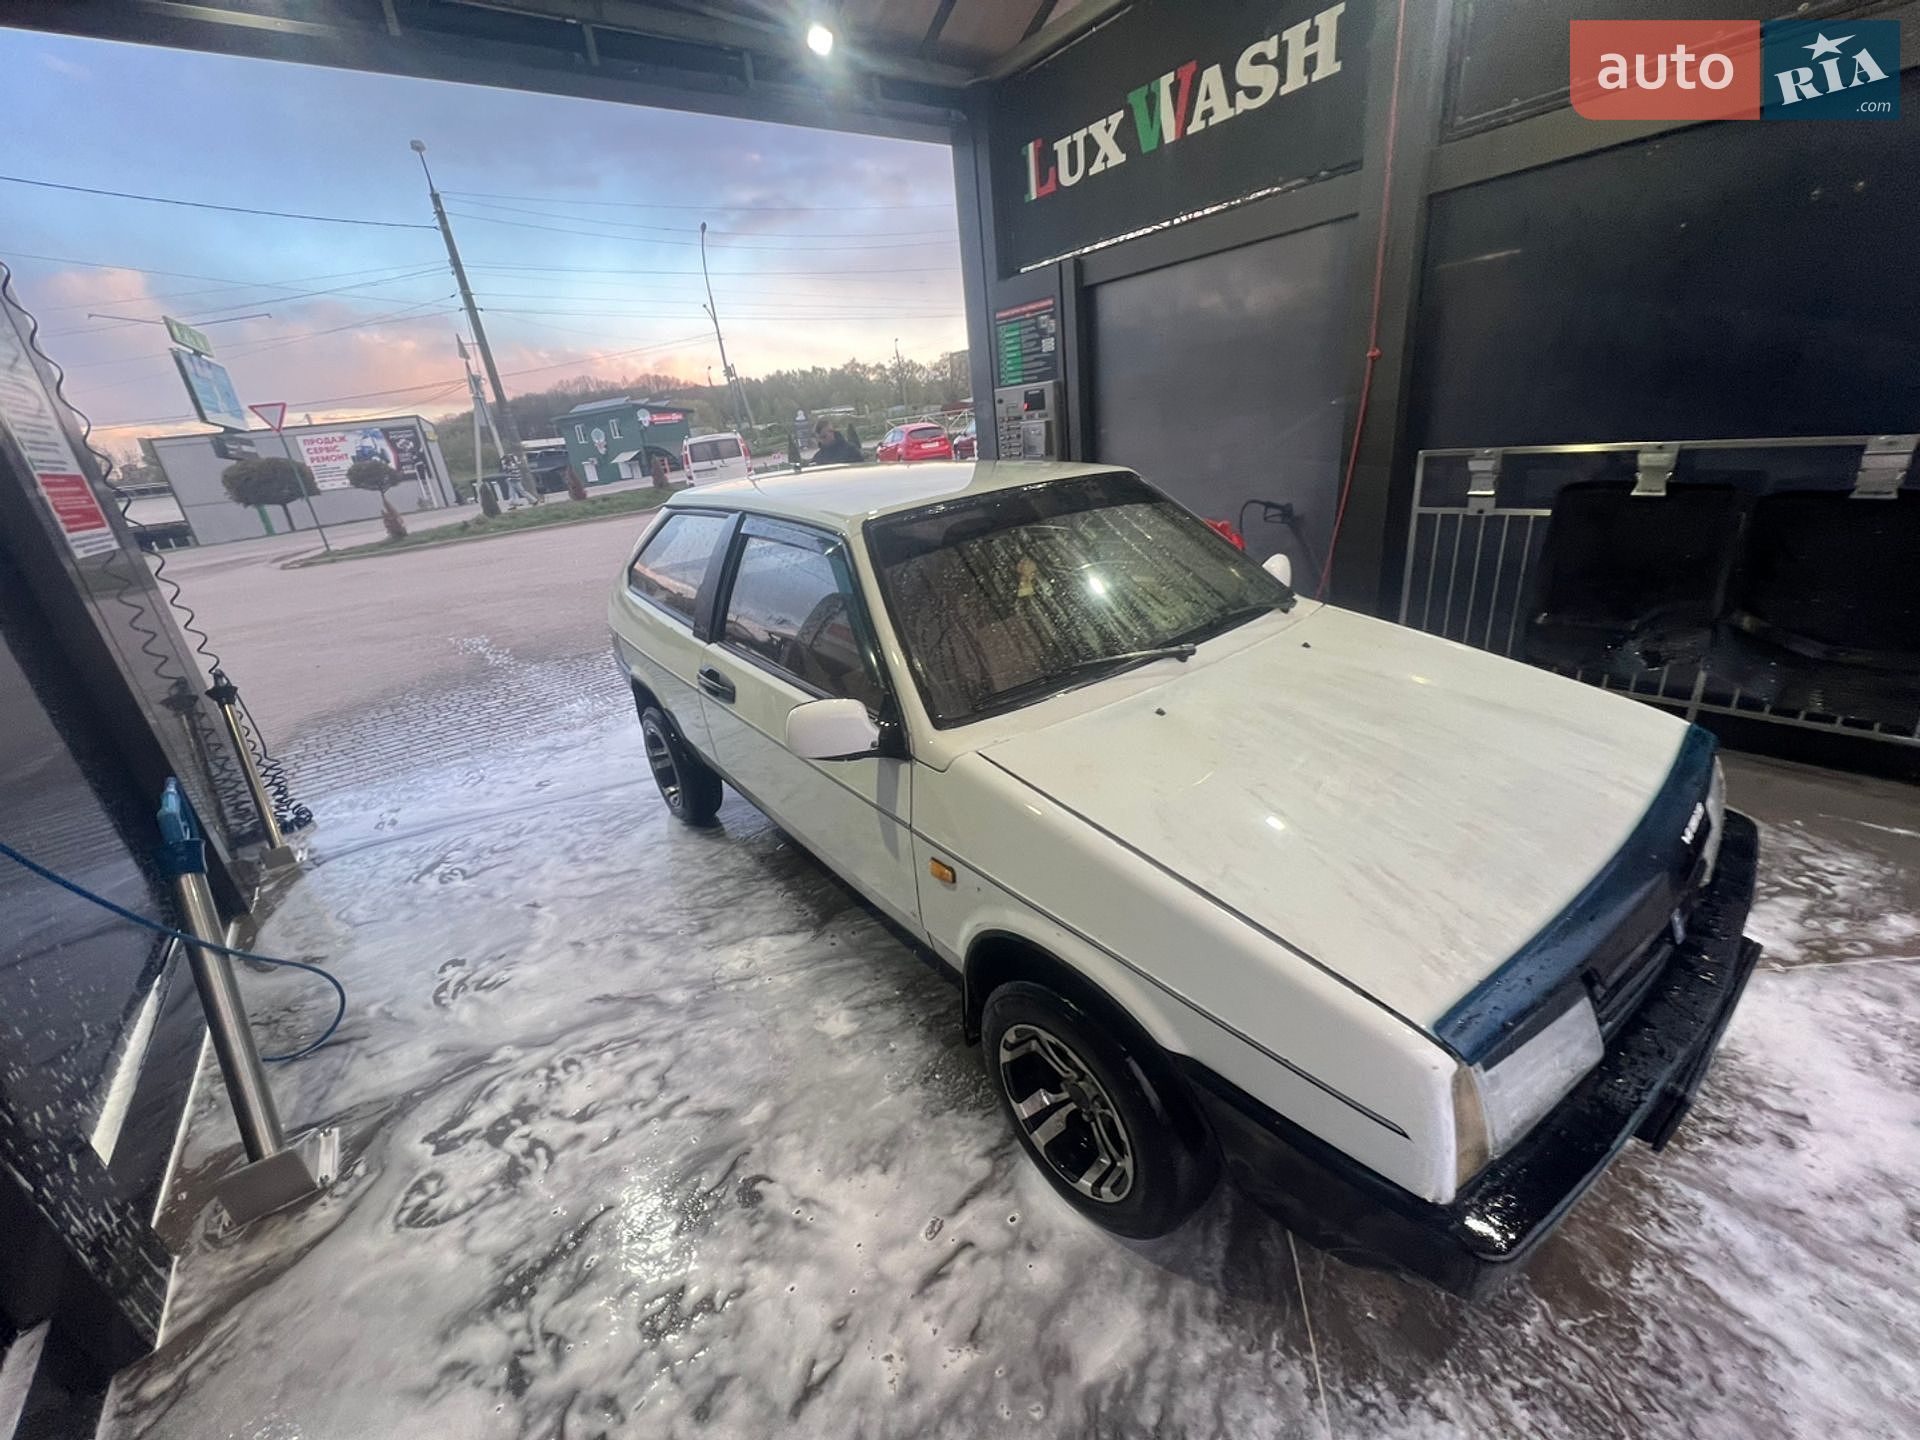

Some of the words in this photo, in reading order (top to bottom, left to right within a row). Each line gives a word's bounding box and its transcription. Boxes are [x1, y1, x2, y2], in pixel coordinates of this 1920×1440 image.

[1021, 109, 1127, 204] LUX
[1127, 2, 1346, 156] WASH
[303, 435, 348, 445] ПРОДАЖ
[306, 445, 340, 455] СЕРВІС
[310, 453, 349, 464] РЕМОНТ
